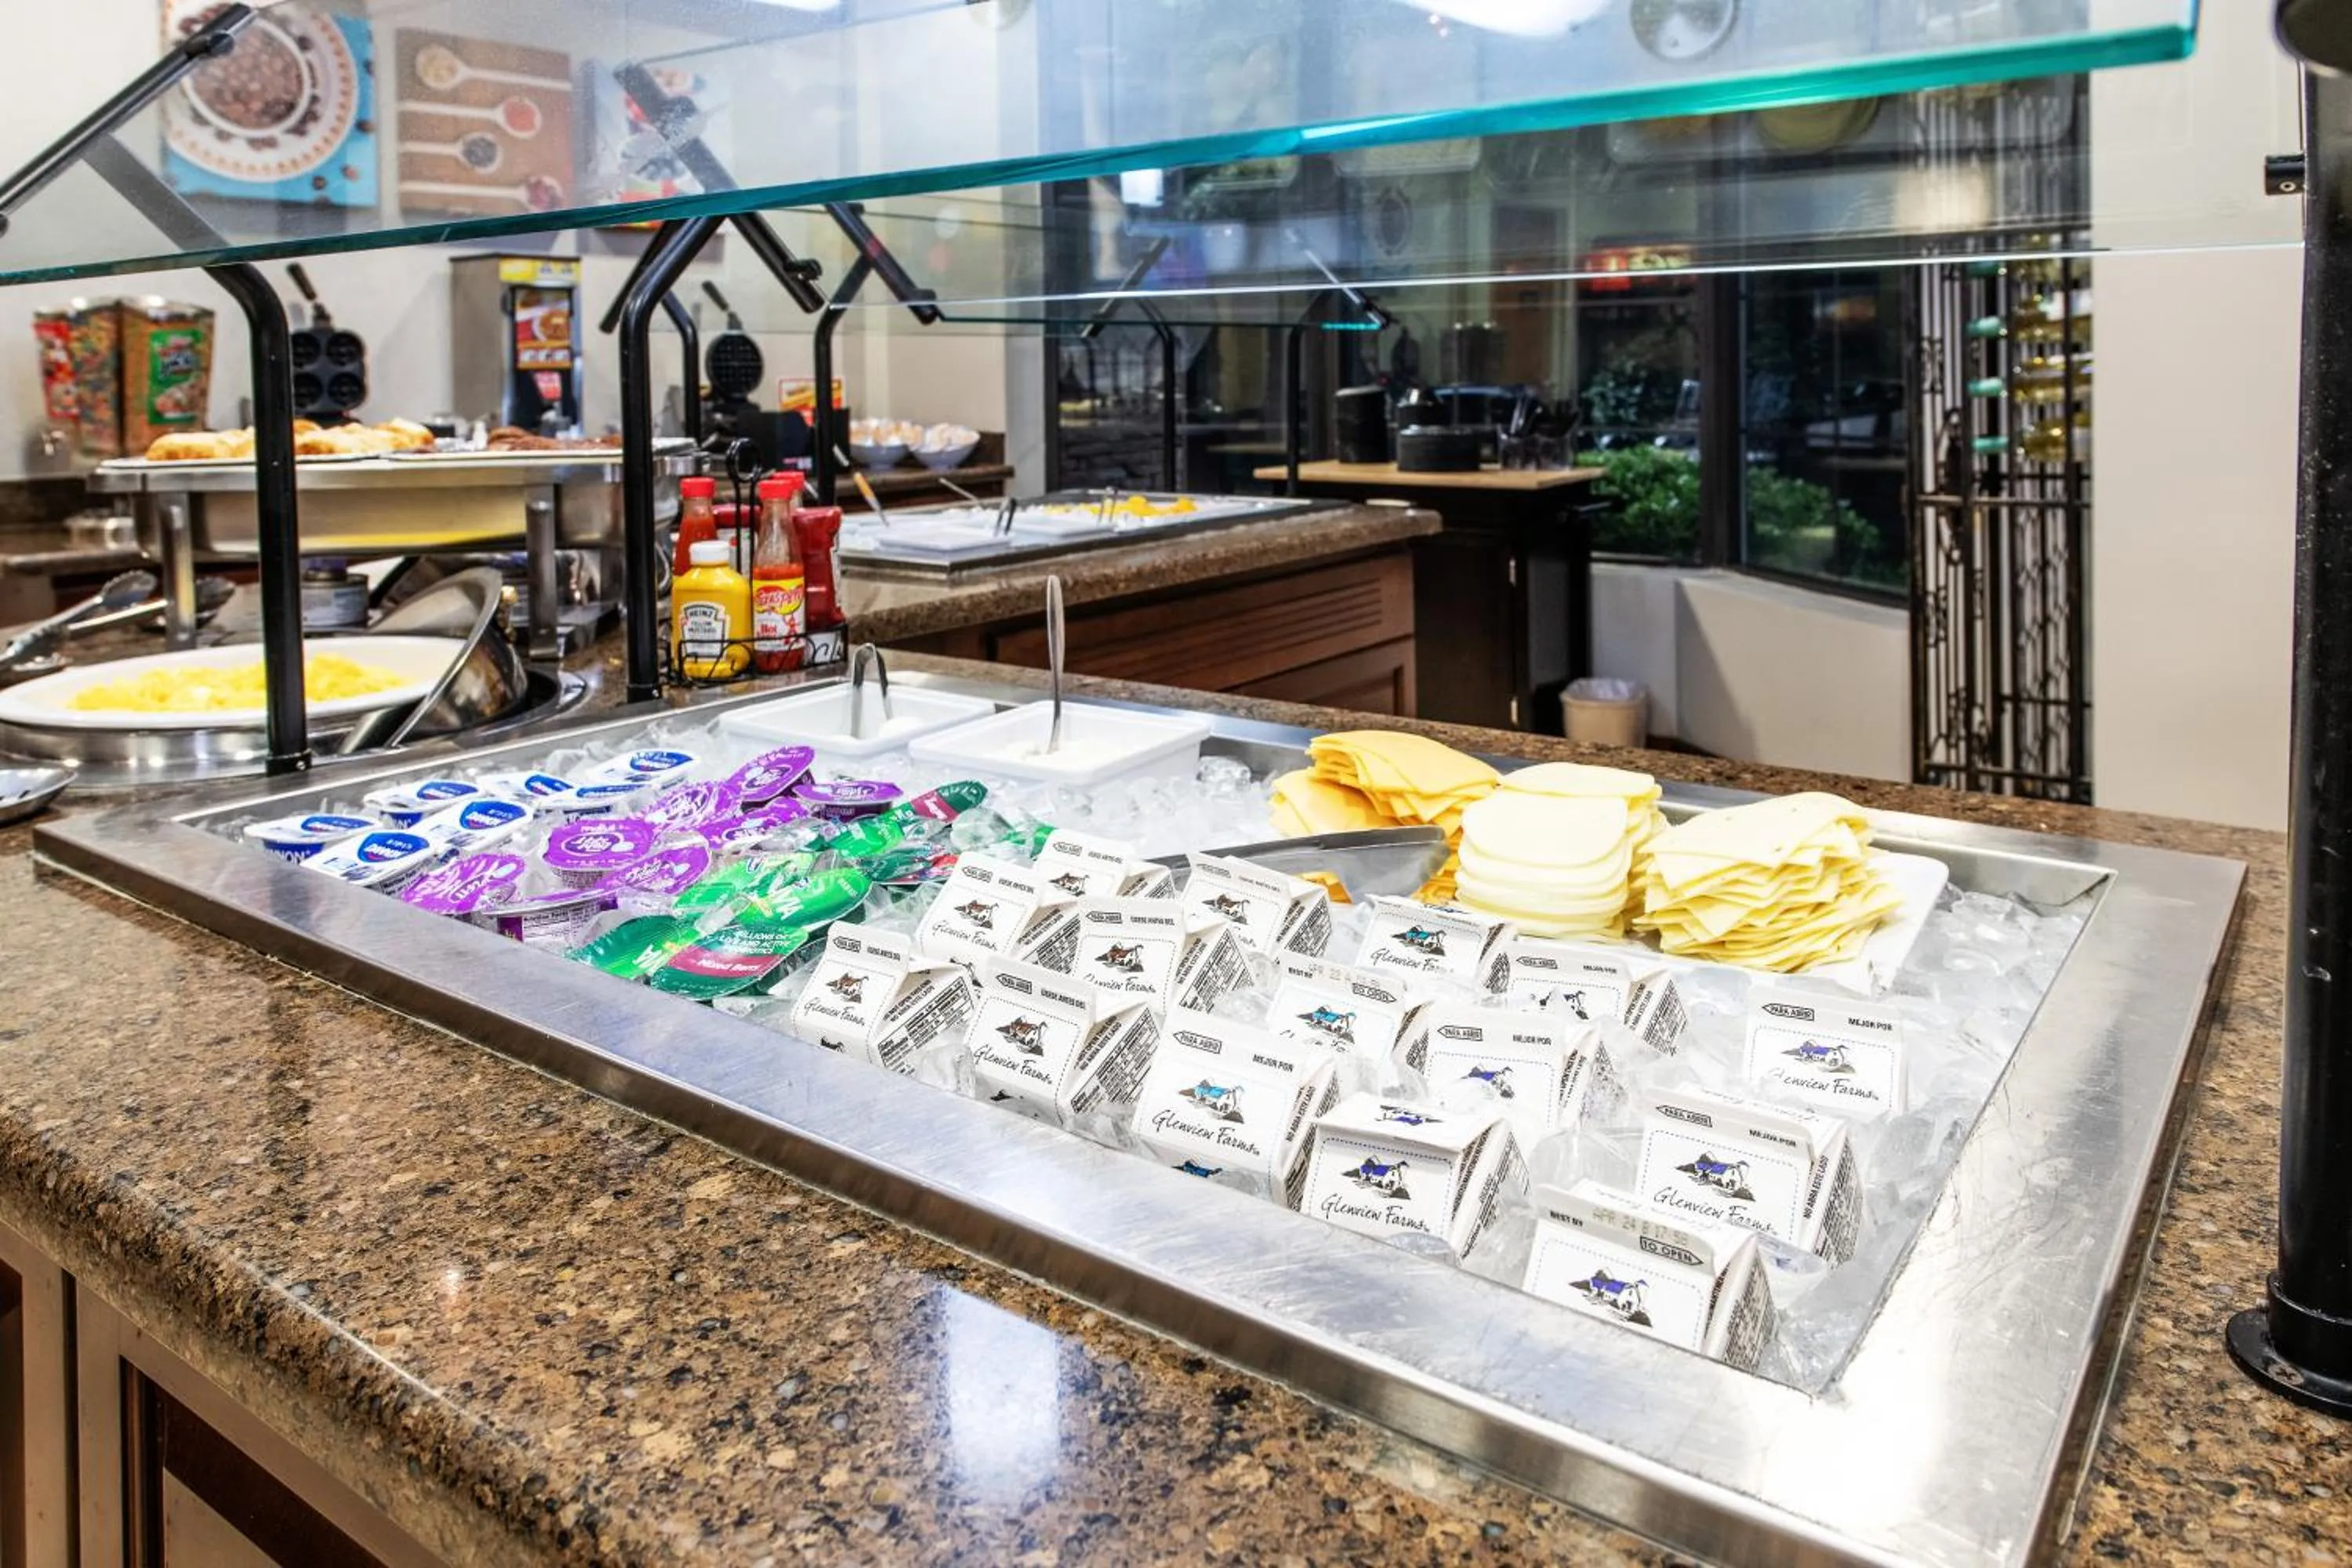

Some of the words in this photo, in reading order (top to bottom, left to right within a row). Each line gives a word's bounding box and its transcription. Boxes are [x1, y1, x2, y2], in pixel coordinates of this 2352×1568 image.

[688, 609, 713, 619] HEINZ
[1370, 947, 1421, 969] Glenview
[1125, 976, 1156, 993] Farms
[804, 996, 842, 1018] Glenview
[1848, 1017, 1875, 1029] MEJOR
[1875, 1022, 1893, 1031] POR
[973, 1044, 1020, 1071] Glenview
[1019, 1059, 1050, 1083] Farms
[1252, 1053, 1277, 1068] MEJOR
[1832, 1078, 1875, 1100] Farms
[1152, 1109, 1214, 1140] Glenview
[1216, 1127, 1257, 1156] Farms
[1810, 1172, 1825, 1189] ESTE
[1804, 1188, 1820, 1207] ABRA
[1321, 1192, 1381, 1220] Glenview
[1385, 1205, 1425, 1232] Farms
[1653, 1186, 1724, 1218] Glenview
[1727, 1205, 1773, 1233] Farms
[1643, 1240, 1657, 1252] TO
[1661, 1246, 1693, 1263] OPEN
